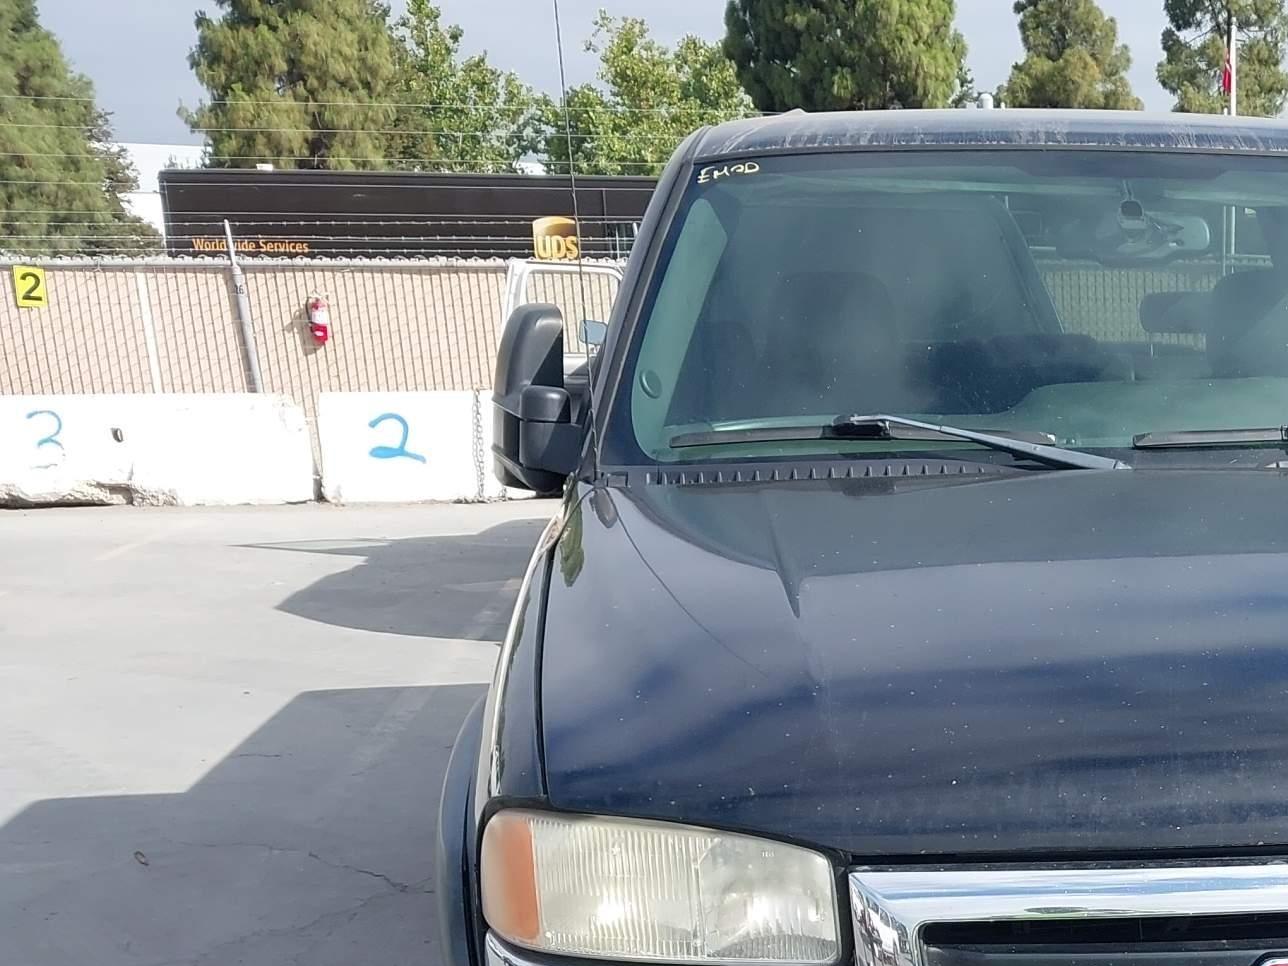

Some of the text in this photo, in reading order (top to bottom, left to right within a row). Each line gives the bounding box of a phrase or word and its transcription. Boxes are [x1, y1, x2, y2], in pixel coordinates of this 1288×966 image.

[259, 239, 310, 253] Services
[20, 272, 43, 301] 2
[368, 413, 427, 465] 2
